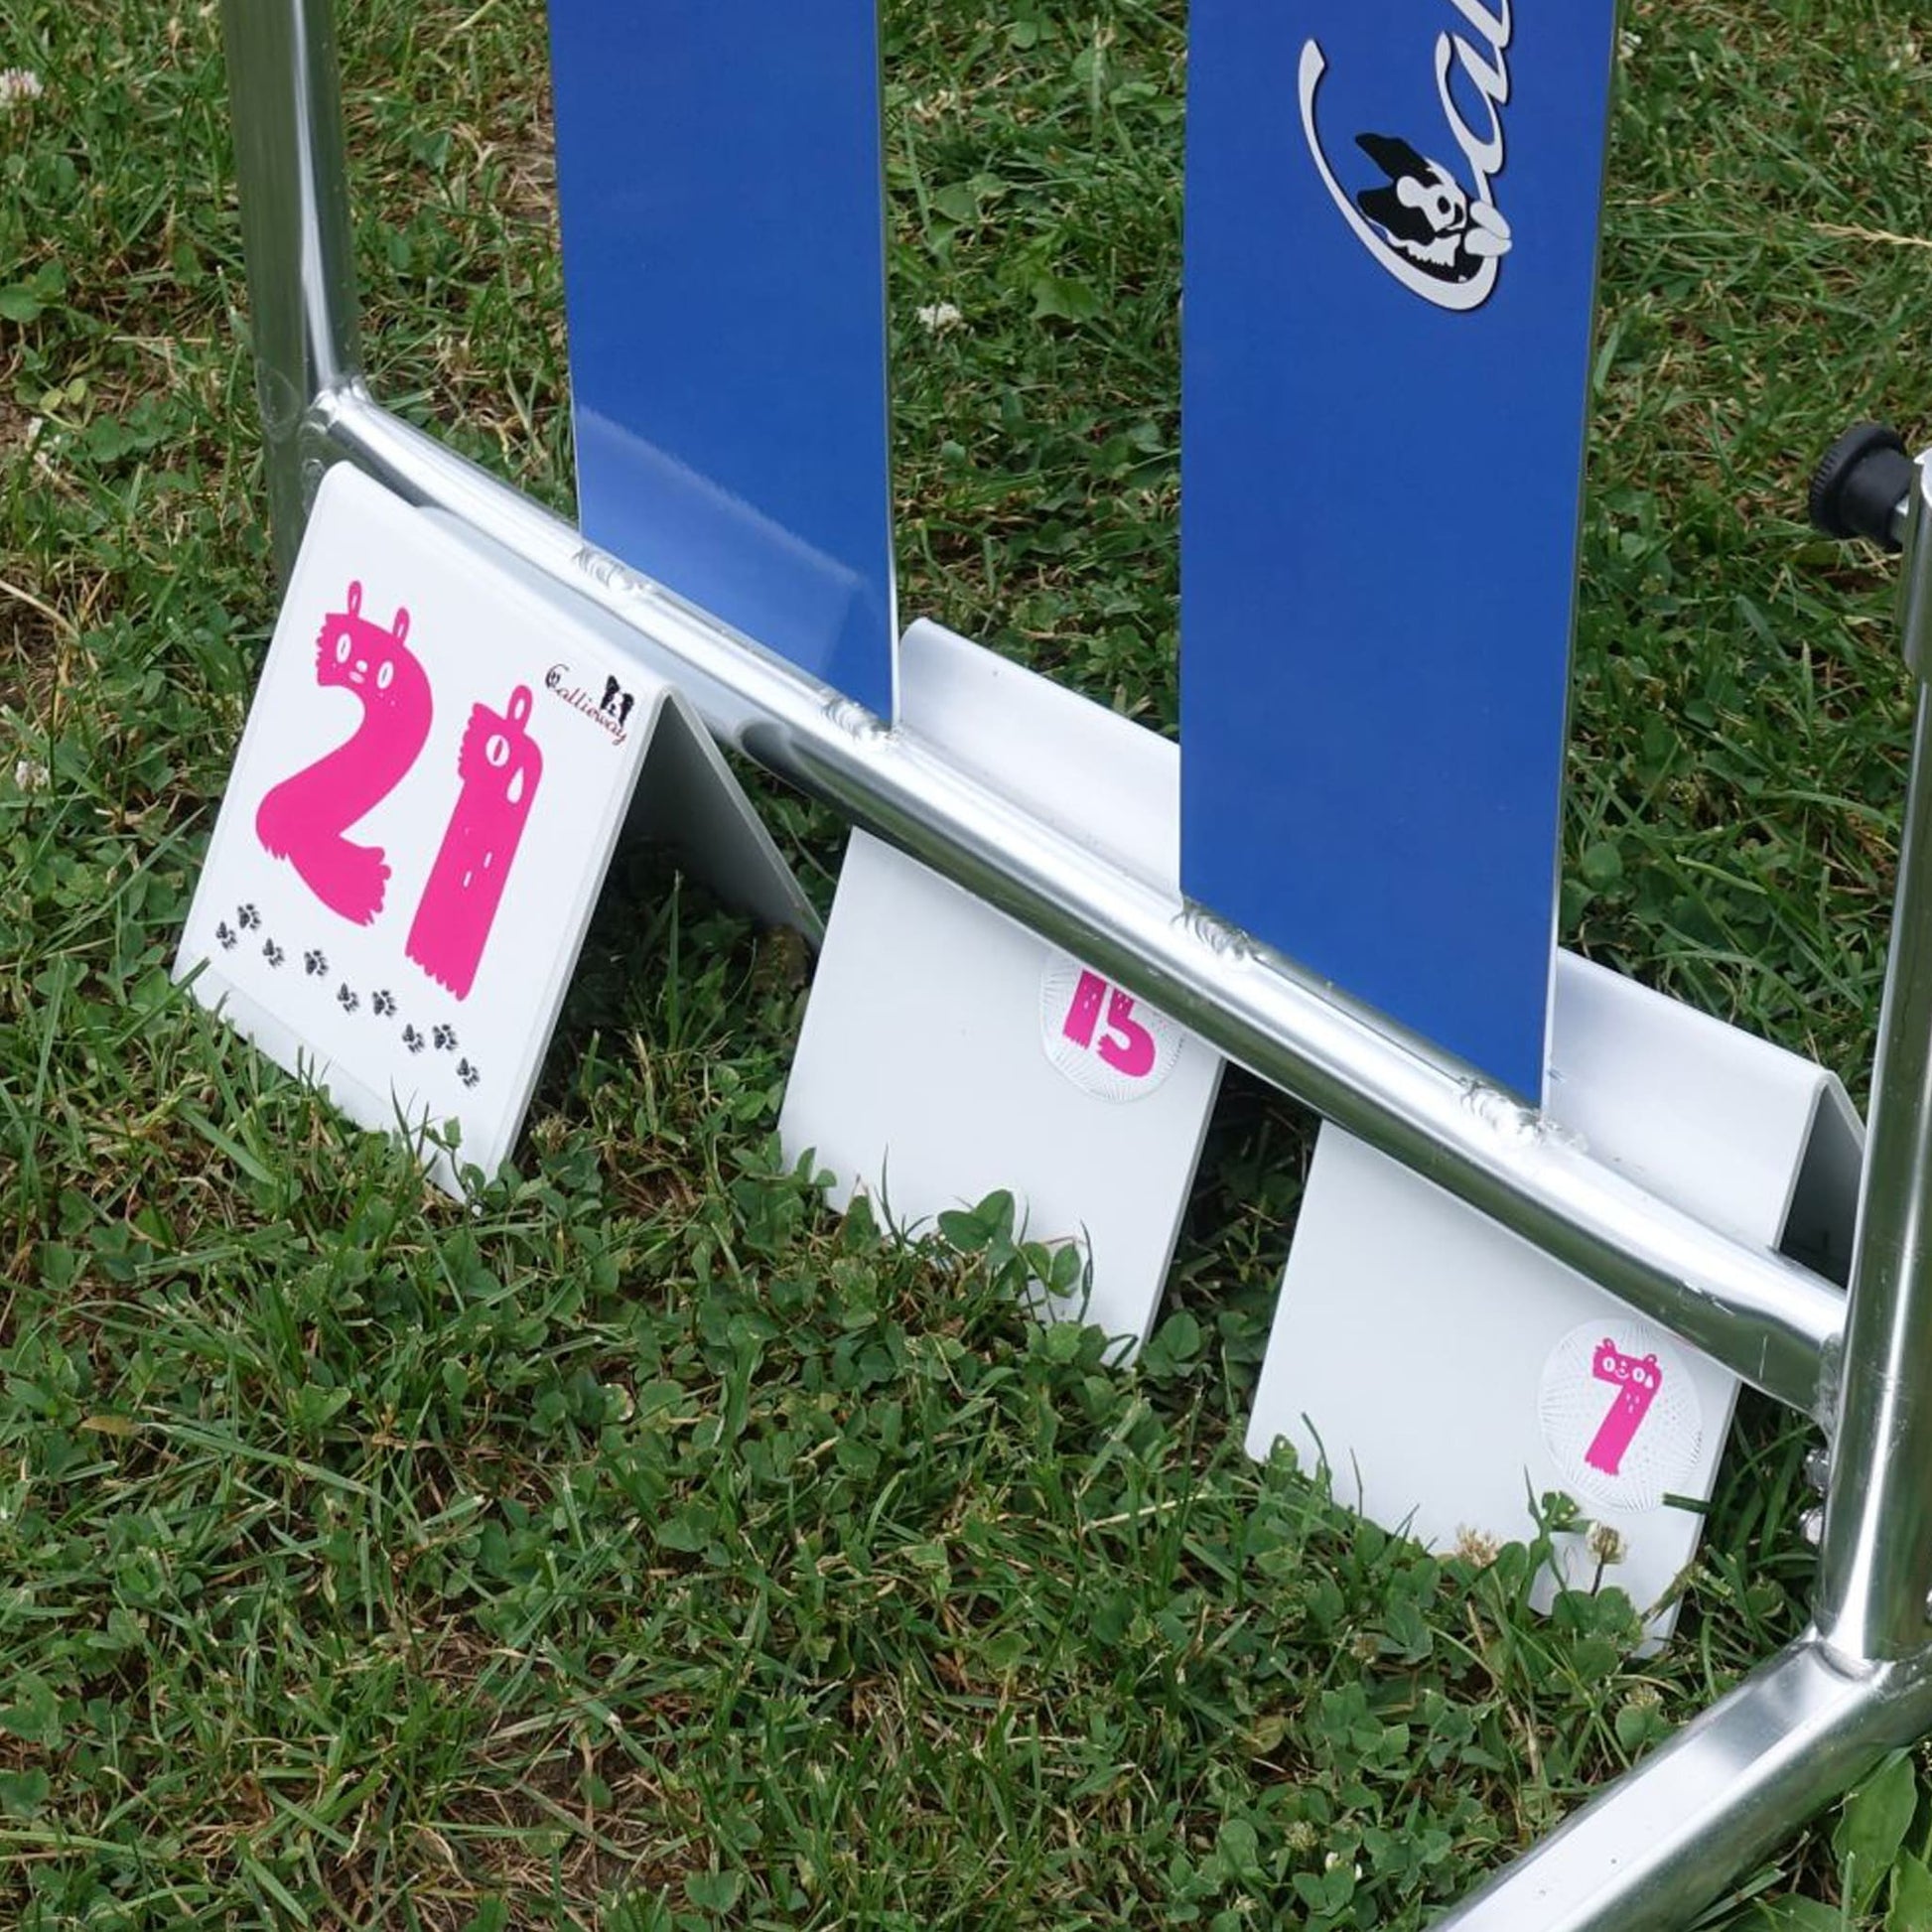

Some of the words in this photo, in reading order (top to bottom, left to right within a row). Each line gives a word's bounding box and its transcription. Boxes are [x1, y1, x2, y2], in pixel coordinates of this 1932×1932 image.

[544, 662, 627, 747] Callieway
[255, 580, 544, 1001] 21
[1585, 1338, 1663, 1476] 7
